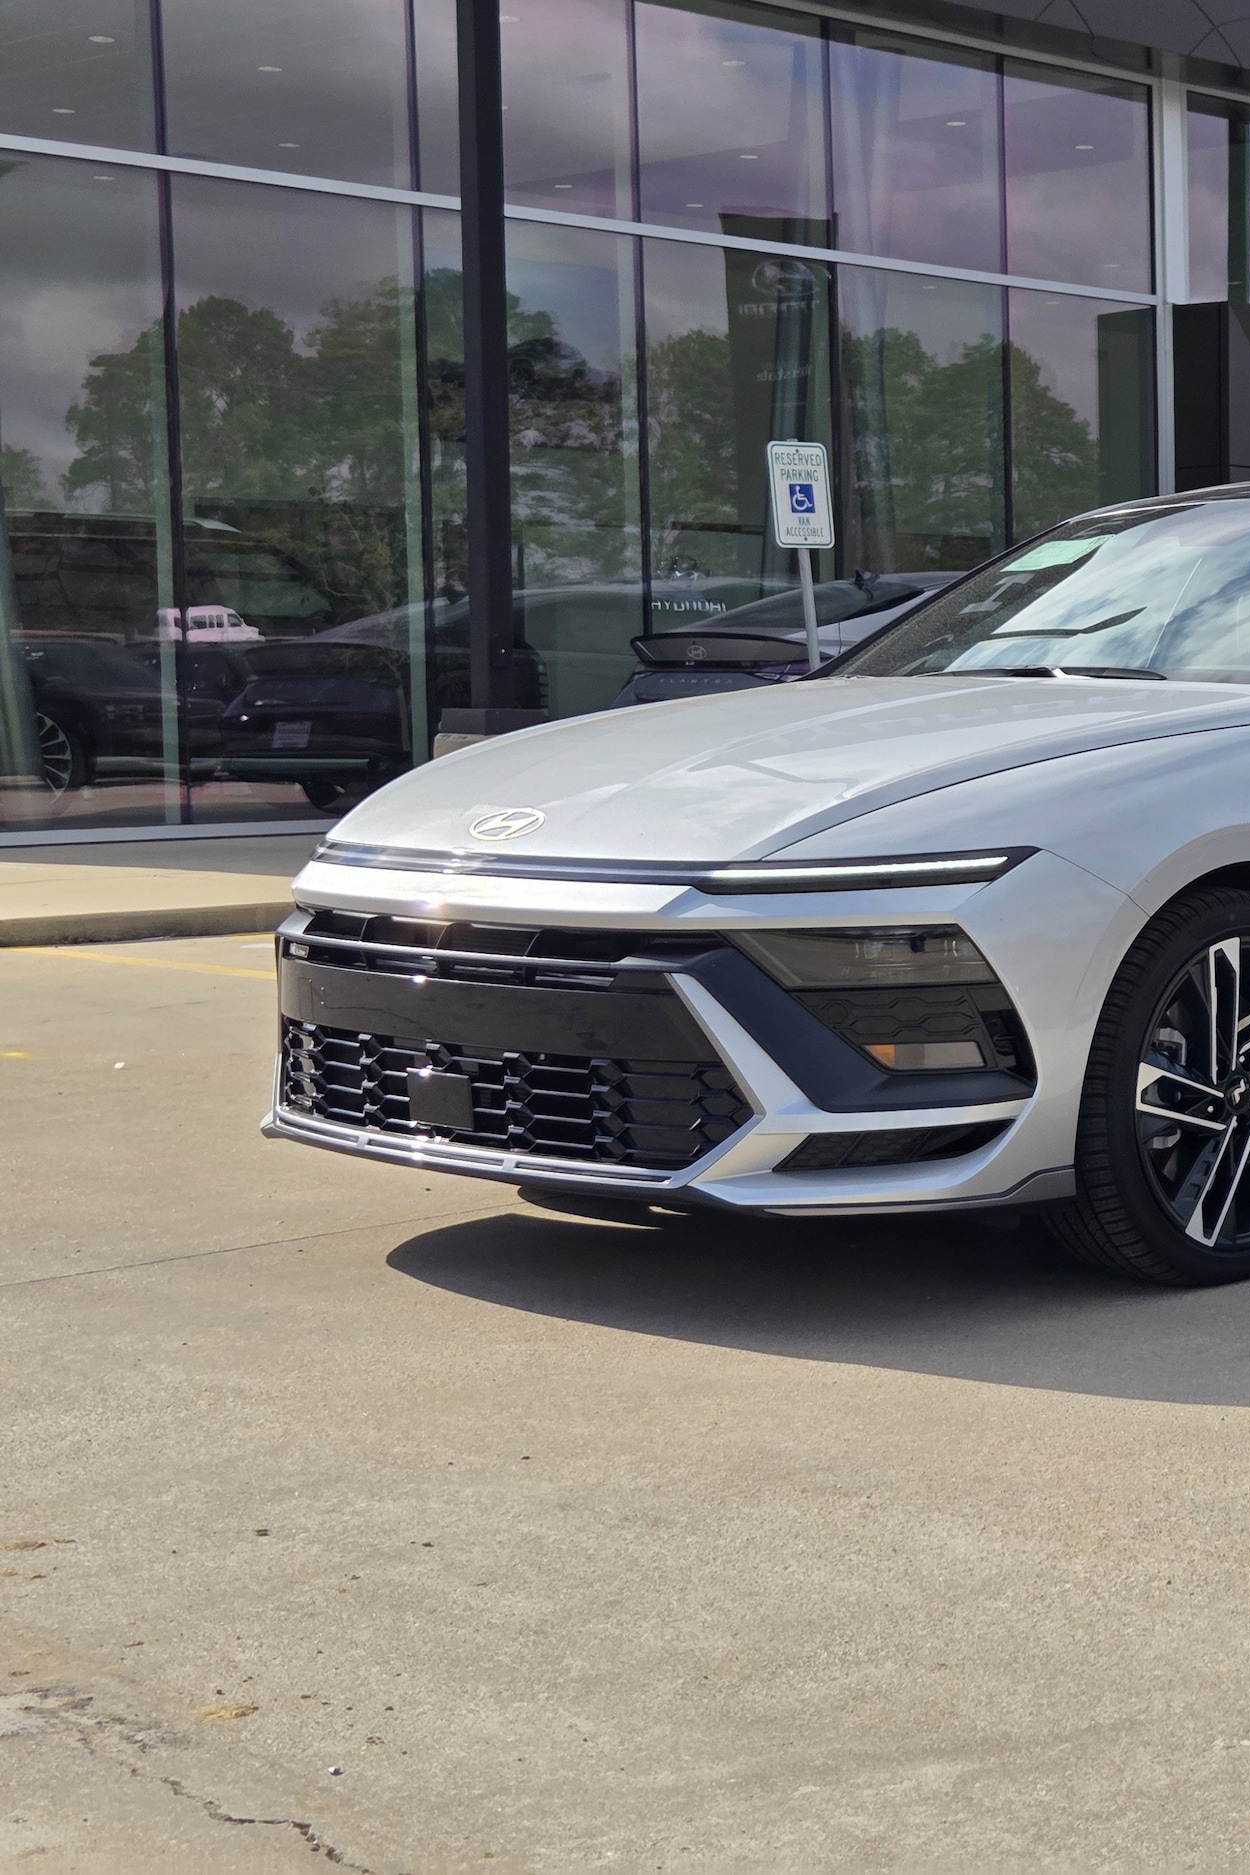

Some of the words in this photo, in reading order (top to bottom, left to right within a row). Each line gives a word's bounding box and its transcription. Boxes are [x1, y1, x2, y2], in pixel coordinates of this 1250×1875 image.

[774, 452, 822, 467] RESERVED
[780, 469, 819, 482] PARKING
[797, 516, 811, 526] VAN
[786, 526, 824, 537] ACCESSIBLE
